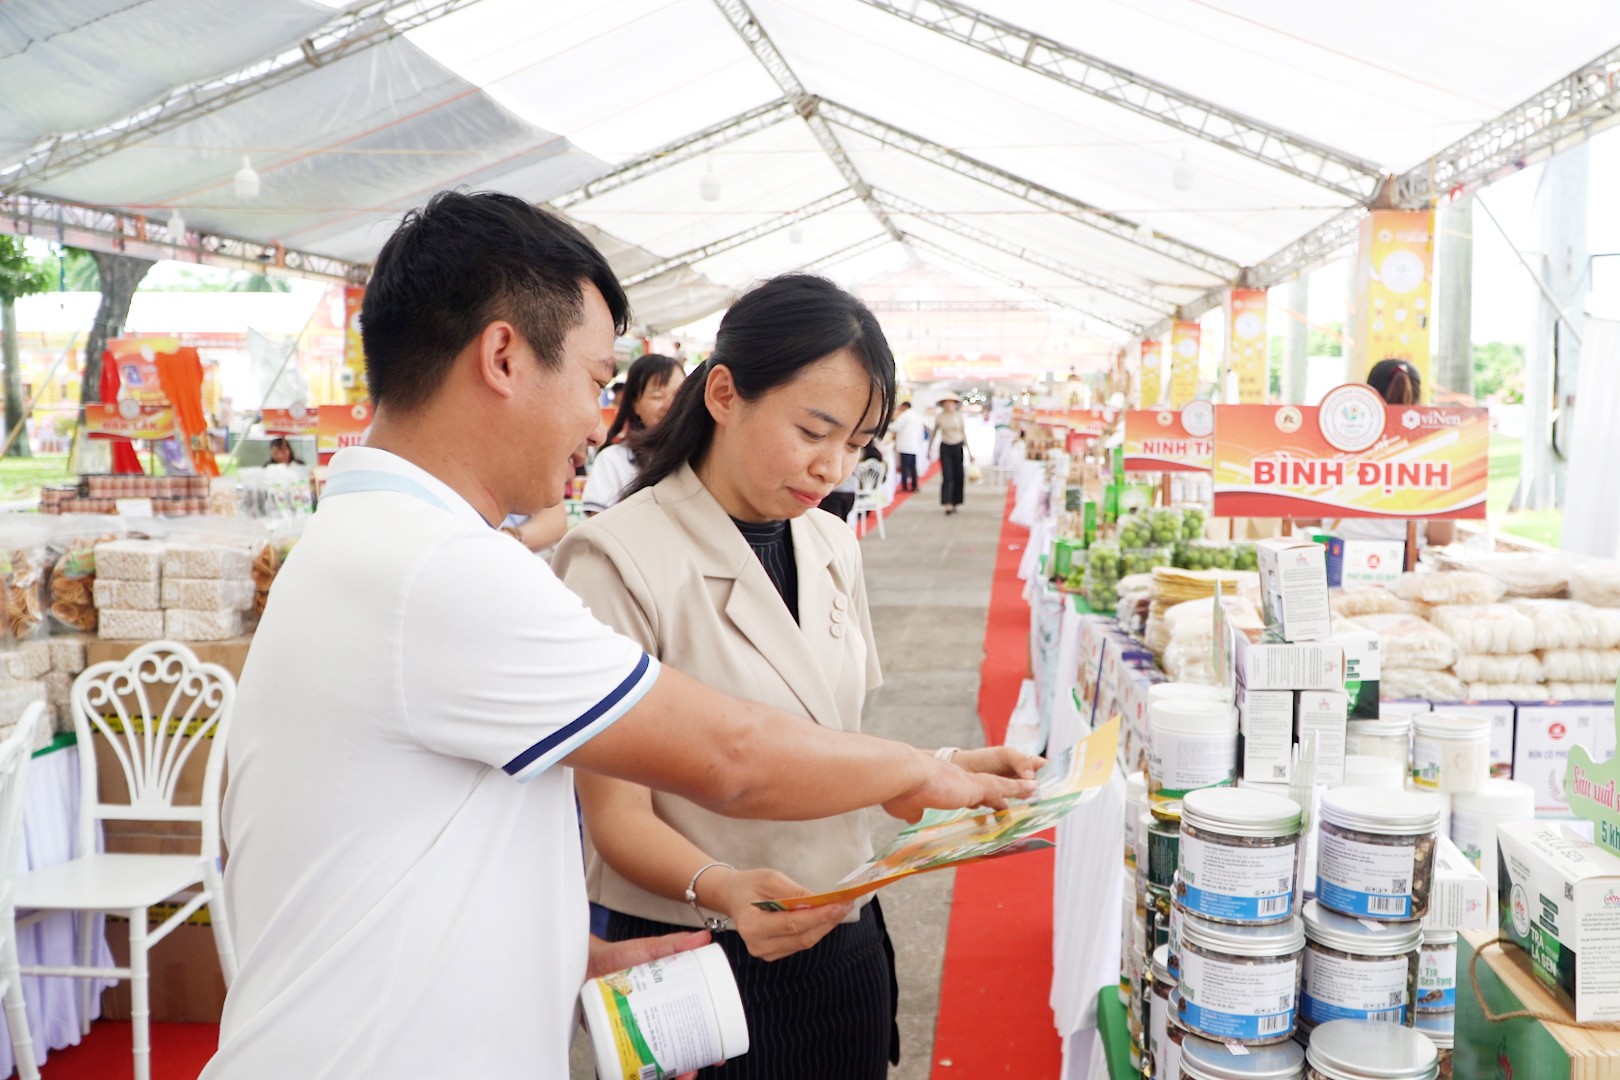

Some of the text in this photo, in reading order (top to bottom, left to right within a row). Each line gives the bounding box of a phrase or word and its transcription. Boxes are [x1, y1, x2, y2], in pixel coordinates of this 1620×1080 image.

[1420, 410, 1461, 425] viNen
[1143, 442, 1187, 454] NINH
[1254, 452, 1448, 494] BÌNH ĐỊNH
[1601, 820, 1608, 843] 5
